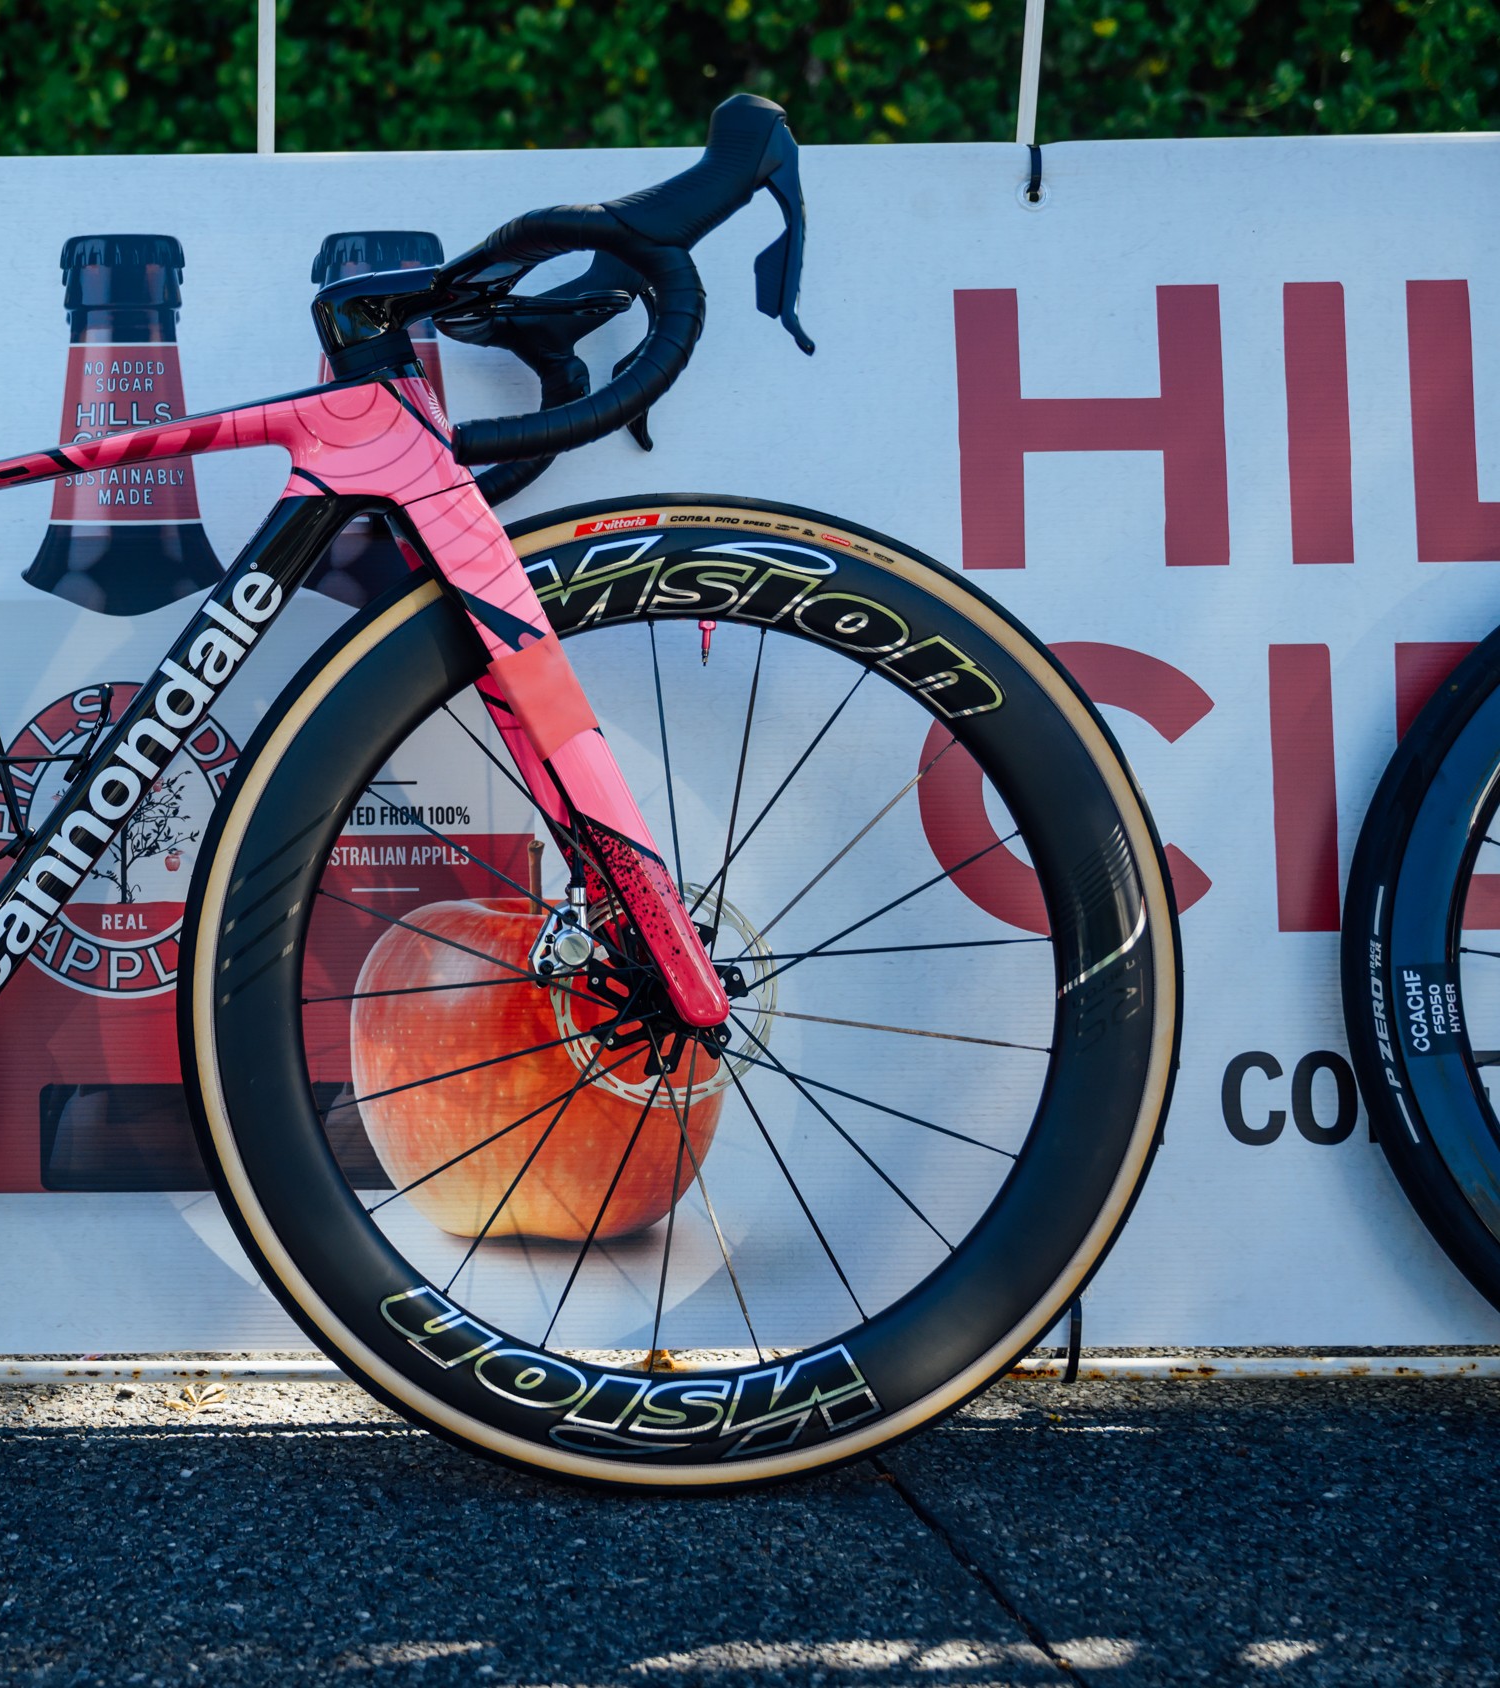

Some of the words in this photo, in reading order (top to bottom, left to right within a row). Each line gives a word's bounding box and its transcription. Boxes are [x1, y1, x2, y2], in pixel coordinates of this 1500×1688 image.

[84, 362, 104, 375] NO
[111, 361, 164, 375] ADDED
[95, 378, 154, 392] SUGAR
[76, 402, 172, 427] HILLS
[65, 468, 184, 487] SUSTAINABLY
[98, 488, 153, 505] MADE
[604, 516, 647, 530] vittoria
[670, 515, 711, 523] CORSA
[714, 516, 740, 525] PRO
[743, 520, 772, 528] SPEED
[380, 806, 424, 825] FROM
[428, 806, 471, 825] 100%
[326, 846, 406, 866] STRALIAN
[410, 845, 470, 865] APPLES
[101, 914, 148, 930] REAL
[37, 920, 183, 990] APPL
[1374, 942, 1382, 968] TLR
[1428, 984, 1447, 1035] FSD50
[1444, 983, 1462, 1033] HYPER
[1370, 976, 1395, 1063] ZERO
[1386, 1069, 1402, 1088] P
